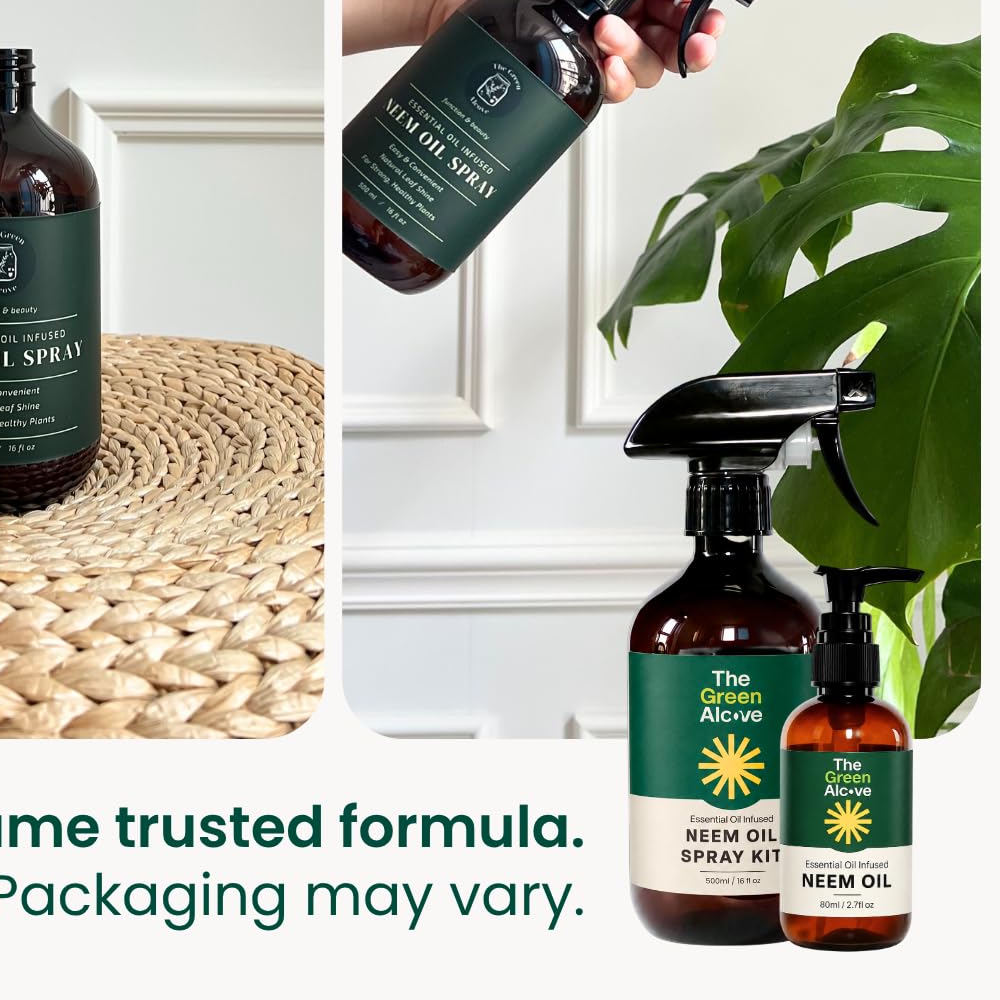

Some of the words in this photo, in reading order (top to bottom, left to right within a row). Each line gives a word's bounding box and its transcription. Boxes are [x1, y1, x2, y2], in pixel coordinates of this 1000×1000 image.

[493, 63, 508, 72] The
[507, 68, 521, 91] Green
[442, 98, 465, 117] function
[470, 120, 490, 140] beauty
[408, 99, 445, 135] ESSENTIAL
[447, 133, 459, 148] OIL
[460, 144, 494, 175] INFUSED
[383, 97, 419, 134] NEEM
[419, 131, 444, 160] OIL
[447, 156, 498, 199] SPRAY
[389, 143, 403, 158] Easy
[409, 159, 444, 193] Convenient
[379, 153, 403, 177] Natural
[401, 172, 418, 191] Leaf
[415, 186, 435, 203] Shine
[361, 154, 371, 166] For
[370, 162, 391, 185] Strong,
[391, 182, 416, 206] Healthy
[415, 201, 436, 221] Plants
[0, 231, 25, 245] Green
[11, 305, 37, 314] beauty
[1, 335, 18, 343] OIL
[23, 329, 66, 342] INFUSED
[24, 340, 83, 366] SPRAY
[17, 402, 40, 411] Shine
[30, 415, 55, 425] Plants
[18, 443, 25, 453] fl
[712, 671, 750, 687] The
[700, 688, 761, 704] Green
[833, 758, 861, 771] The
[825, 771, 871, 783] Green
[690, 815, 728, 823] Essential
[730, 815, 741, 823] Oil
[744, 815, 773, 823] Infused
[686, 829, 739, 842] NEEM
[747, 829, 777, 842] OIL
[681, 849, 744, 863] SPRAY
[752, 849, 780, 862] KIT
[806, 860, 842, 869] Essential
[845, 860, 856, 869] Oil
[859, 860, 888, 869] Infused
[802, 874, 854, 888] NEEM
[862, 874, 891, 888] OIL
